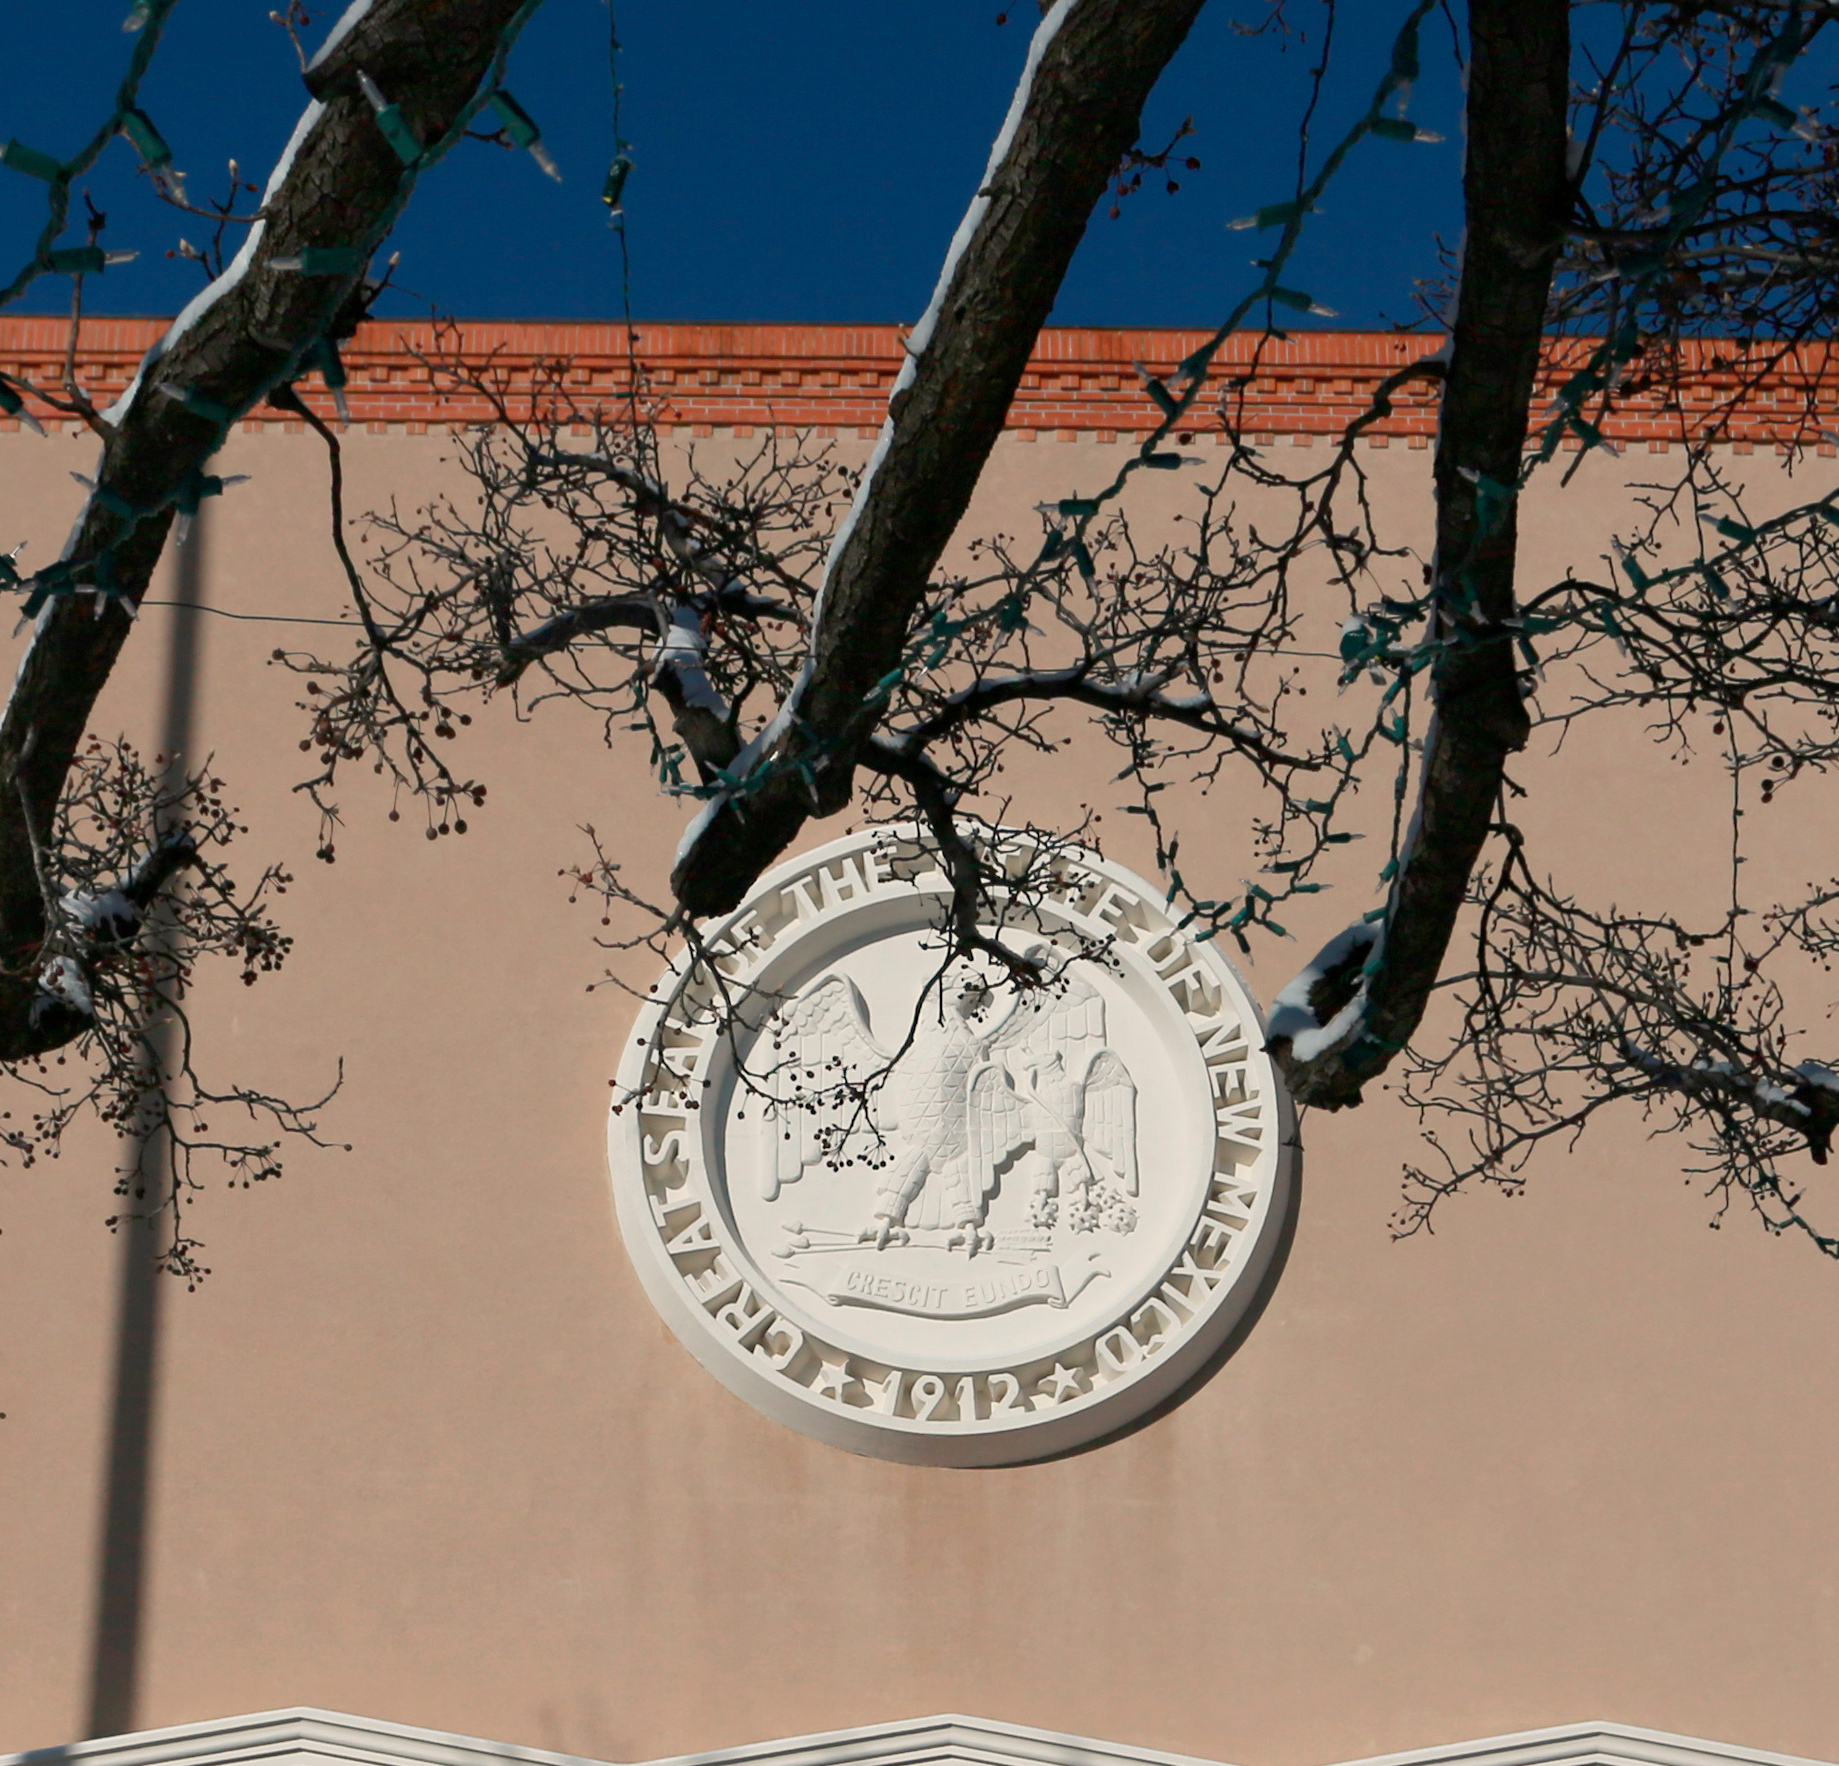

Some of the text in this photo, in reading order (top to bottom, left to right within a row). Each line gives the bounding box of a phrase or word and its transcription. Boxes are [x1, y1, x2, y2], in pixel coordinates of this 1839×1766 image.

[779, 845, 899, 914] THE
[702, 909, 768, 977] OF
[1140, 925, 1222, 991] OF
[642, 1003, 714, 1167] SEAL
[1195, 1014, 1264, 1150] NEW
[648, 1193, 803, 1371] GREAT
[846, 1268, 1050, 1309] CRESCIT EUNDO
[1094, 1171, 1258, 1372] MEXICO
[874, 1369, 1027, 1422] 1912
